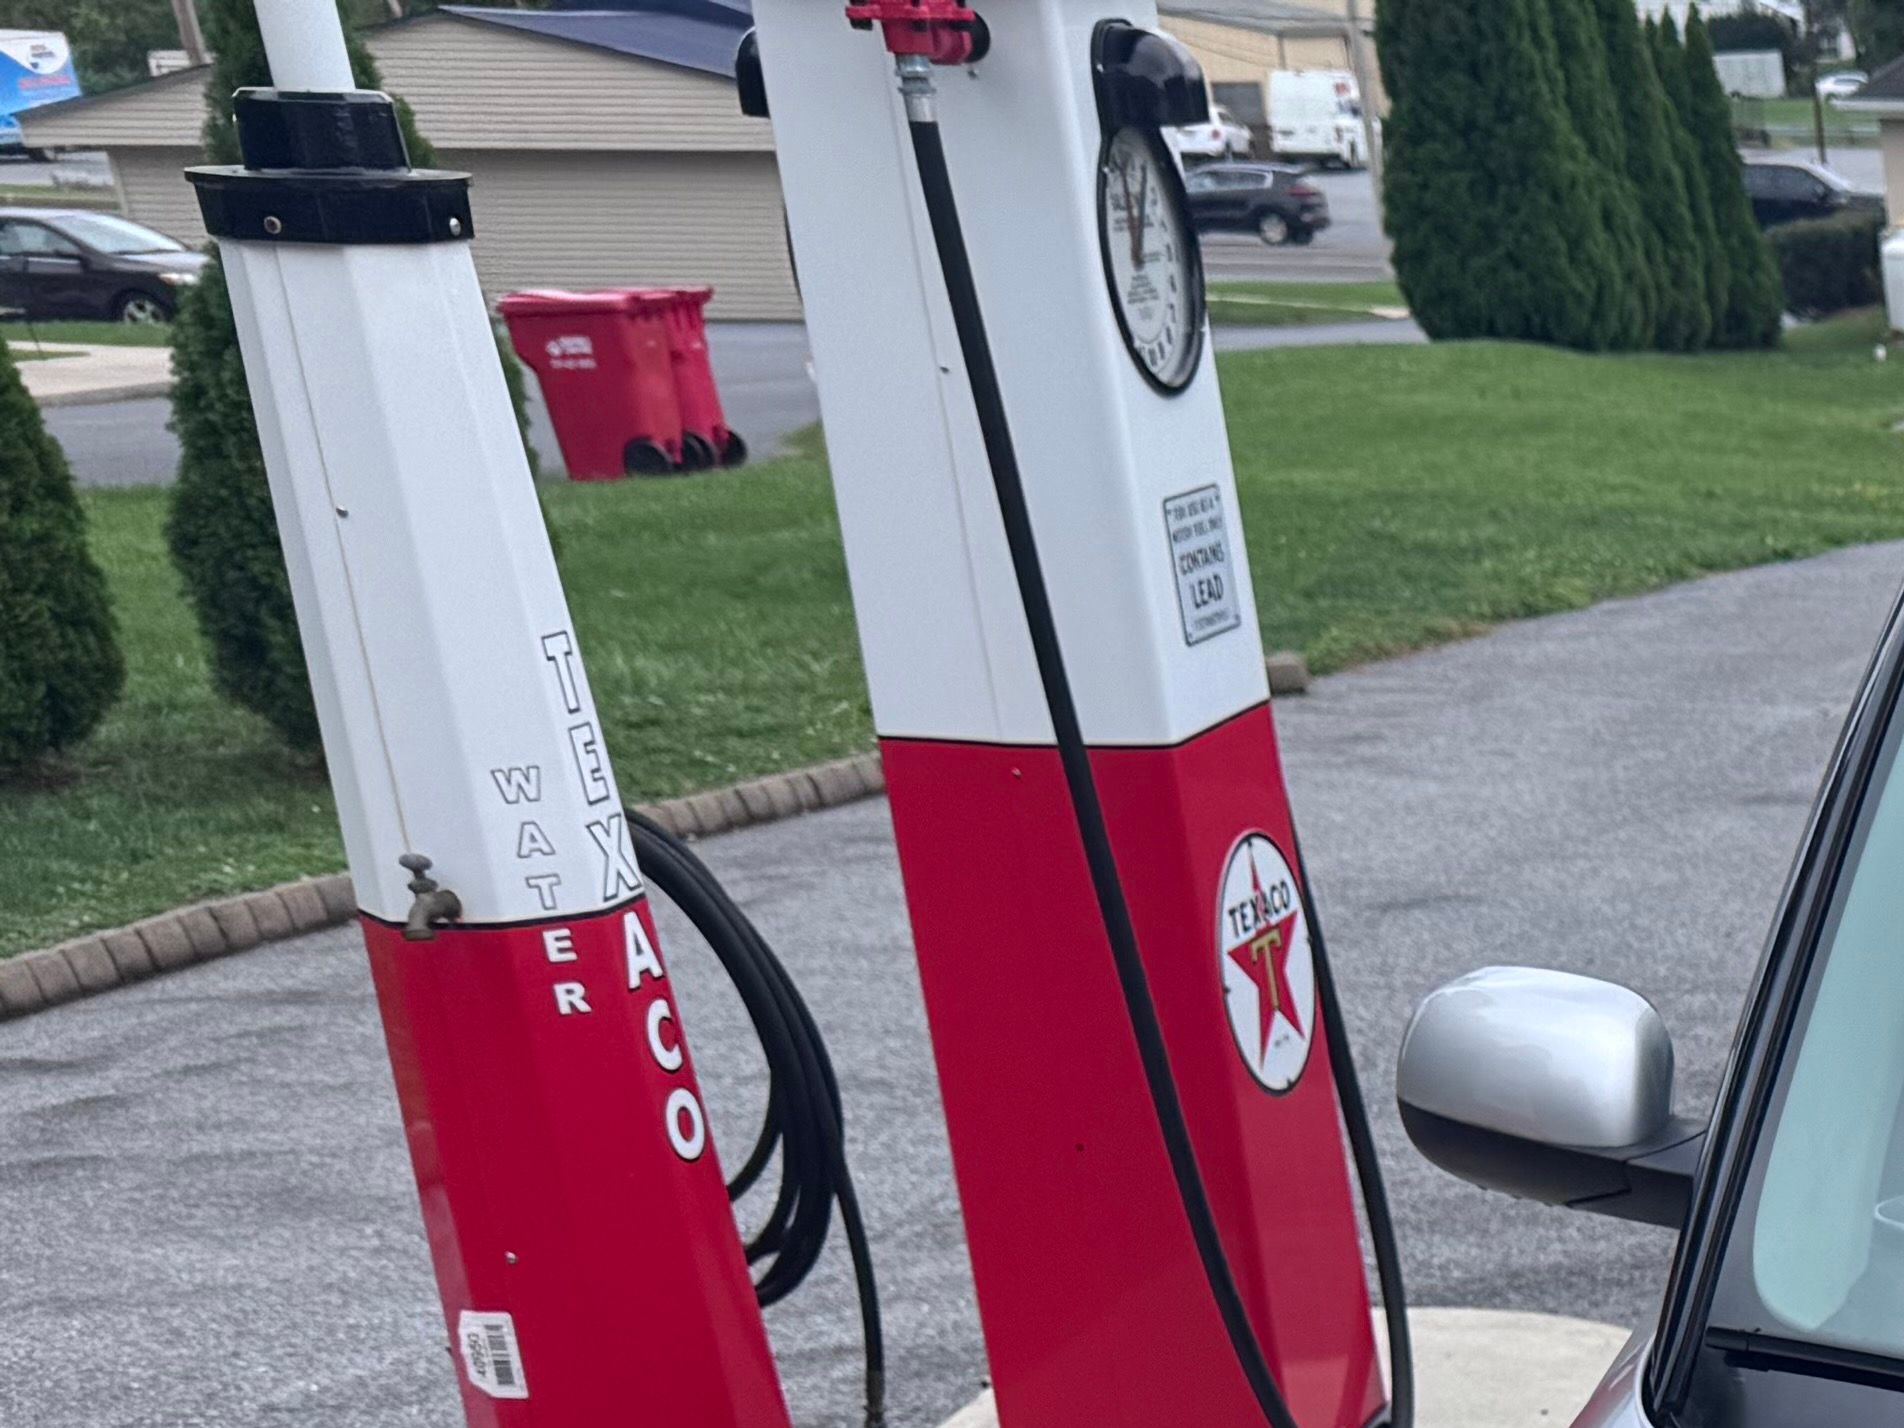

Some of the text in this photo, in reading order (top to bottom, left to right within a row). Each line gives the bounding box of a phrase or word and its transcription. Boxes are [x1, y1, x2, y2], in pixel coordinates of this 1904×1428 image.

[1179, 542, 1225, 575] CONTAINS
[1190, 574, 1224, 608] LEAD
[490, 765, 593, 1016] WATER
[540, 629, 705, 1162] TEXACO
[1227, 879, 1292, 940] TEXACO
